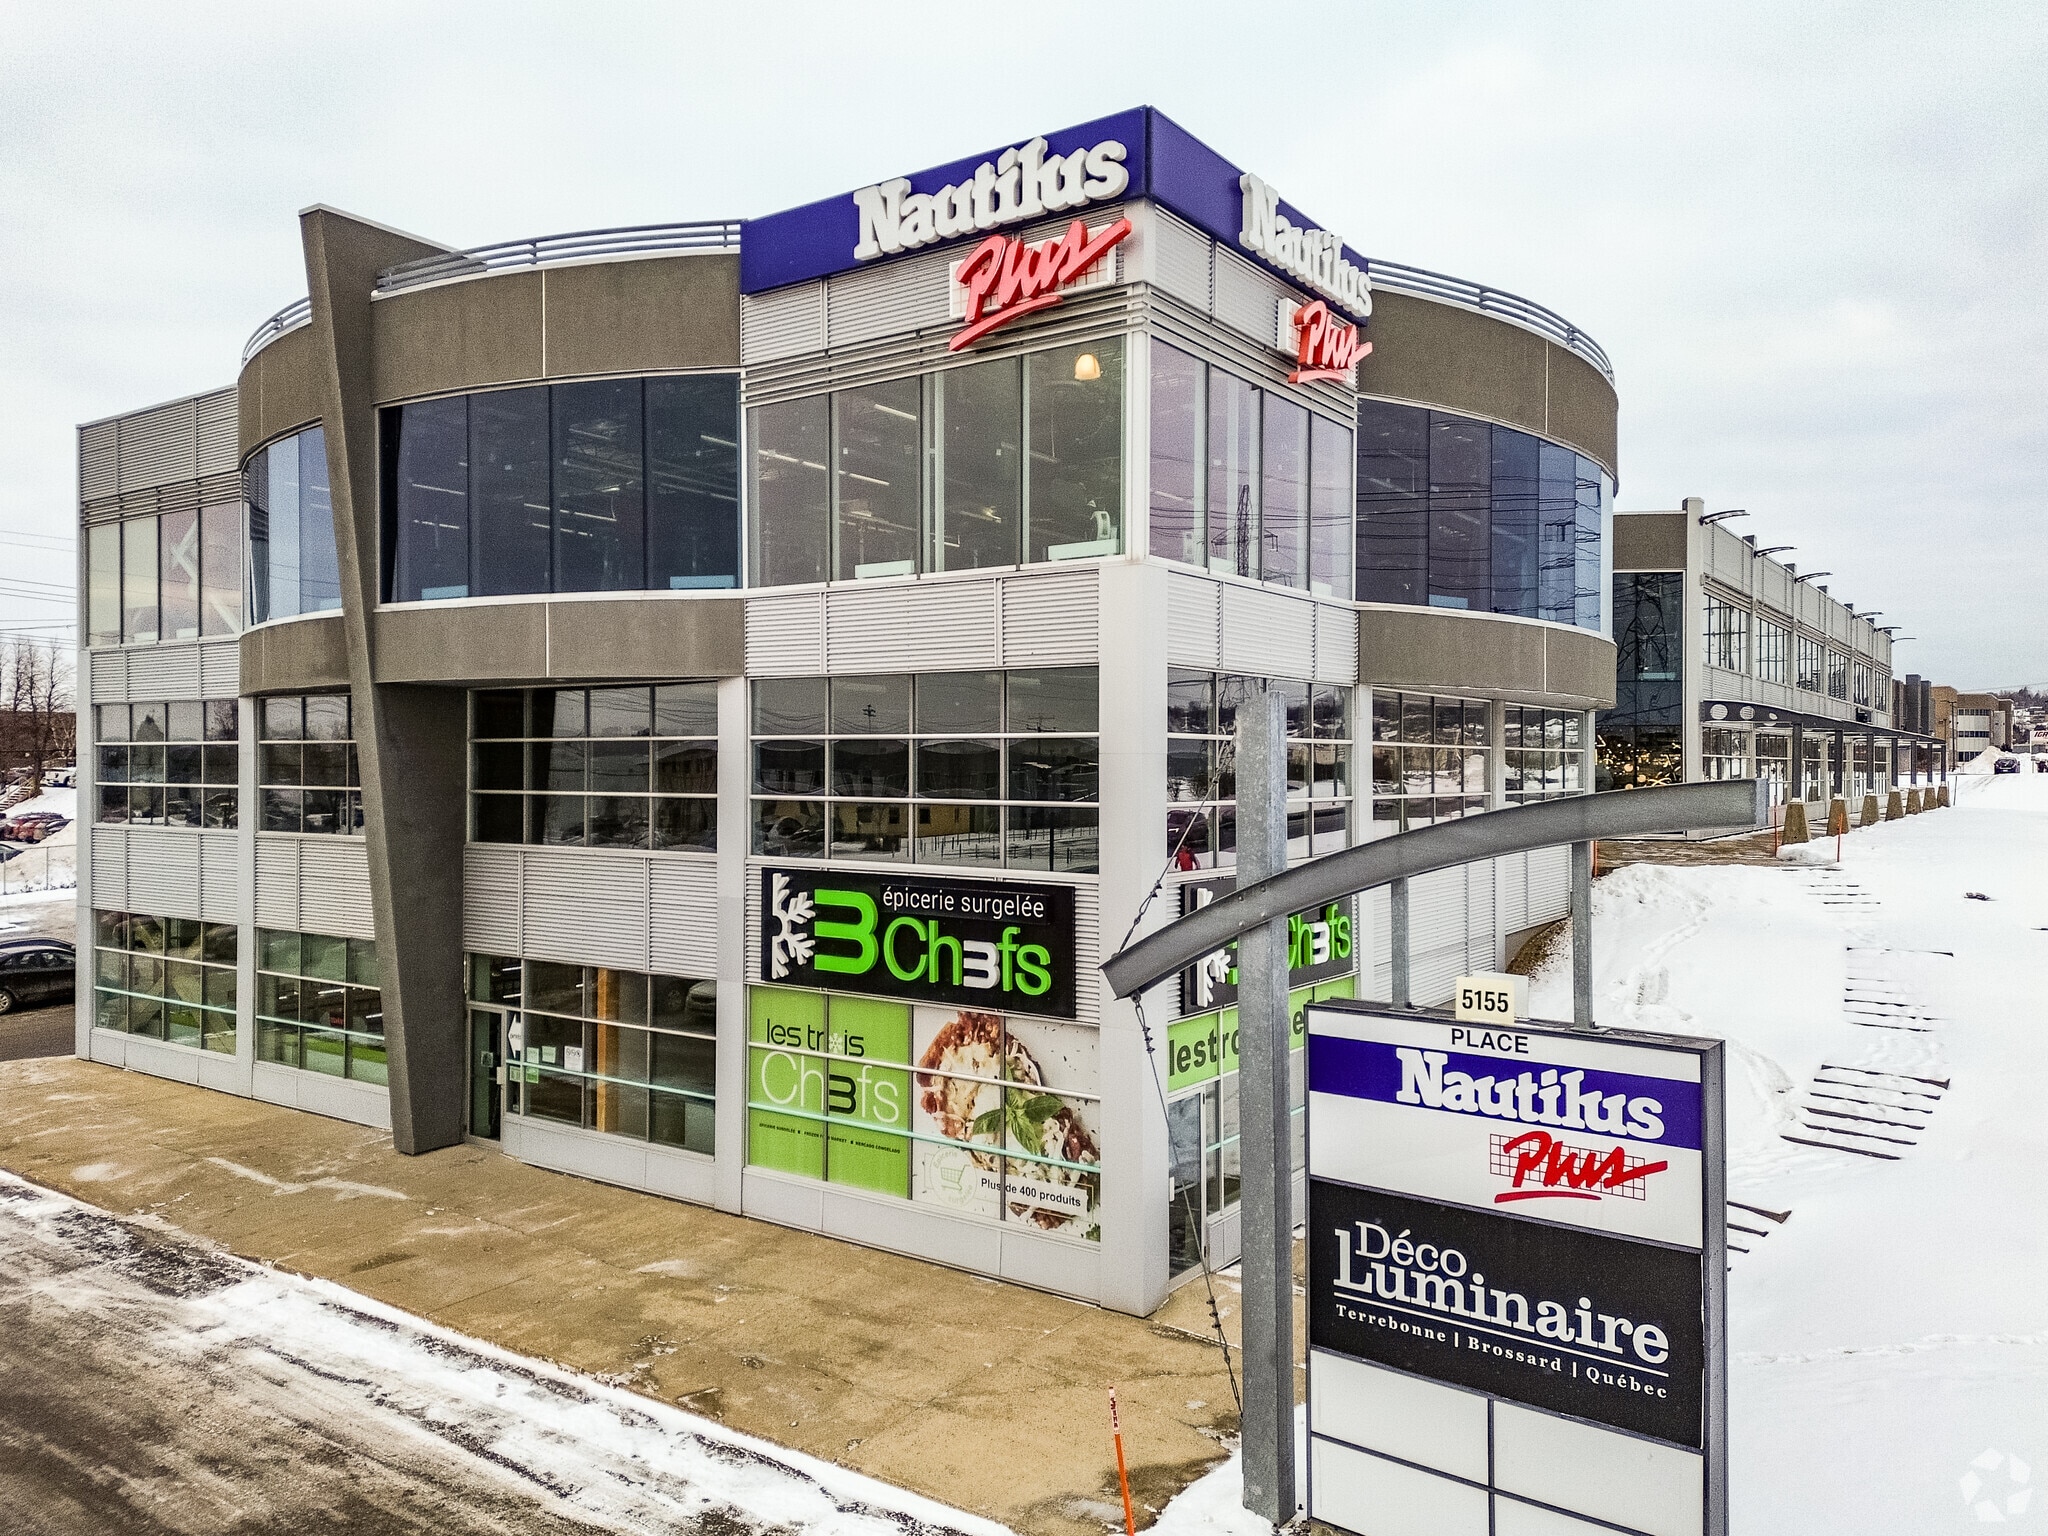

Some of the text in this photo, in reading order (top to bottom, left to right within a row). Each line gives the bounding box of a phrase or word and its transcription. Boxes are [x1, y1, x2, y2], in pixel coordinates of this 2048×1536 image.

[854, 136, 1129, 260] Nautilus
[1239, 173, 1372, 316] Nautilus
[952, 218, 1132, 350] Plus
[1292, 301, 1372, 380] Plus
[883, 886, 1045, 919] épicerie surgelée
[767, 1018, 801, 1048] les
[1462, 989, 1509, 1013] 5155
[1451, 1028, 1529, 1055] PLACE
[1396, 1047, 1665, 1140] Nautilus
[981, 1177, 1081, 1207] Plus de 400 produits
[1503, 1130, 1668, 1200] Plus
[1355, 1220, 1467, 1277] Déco
[1333, 1229, 1669, 1364] Luminaire
[1336, 1303, 1668, 1400] Terrebonne Brossard Québec
